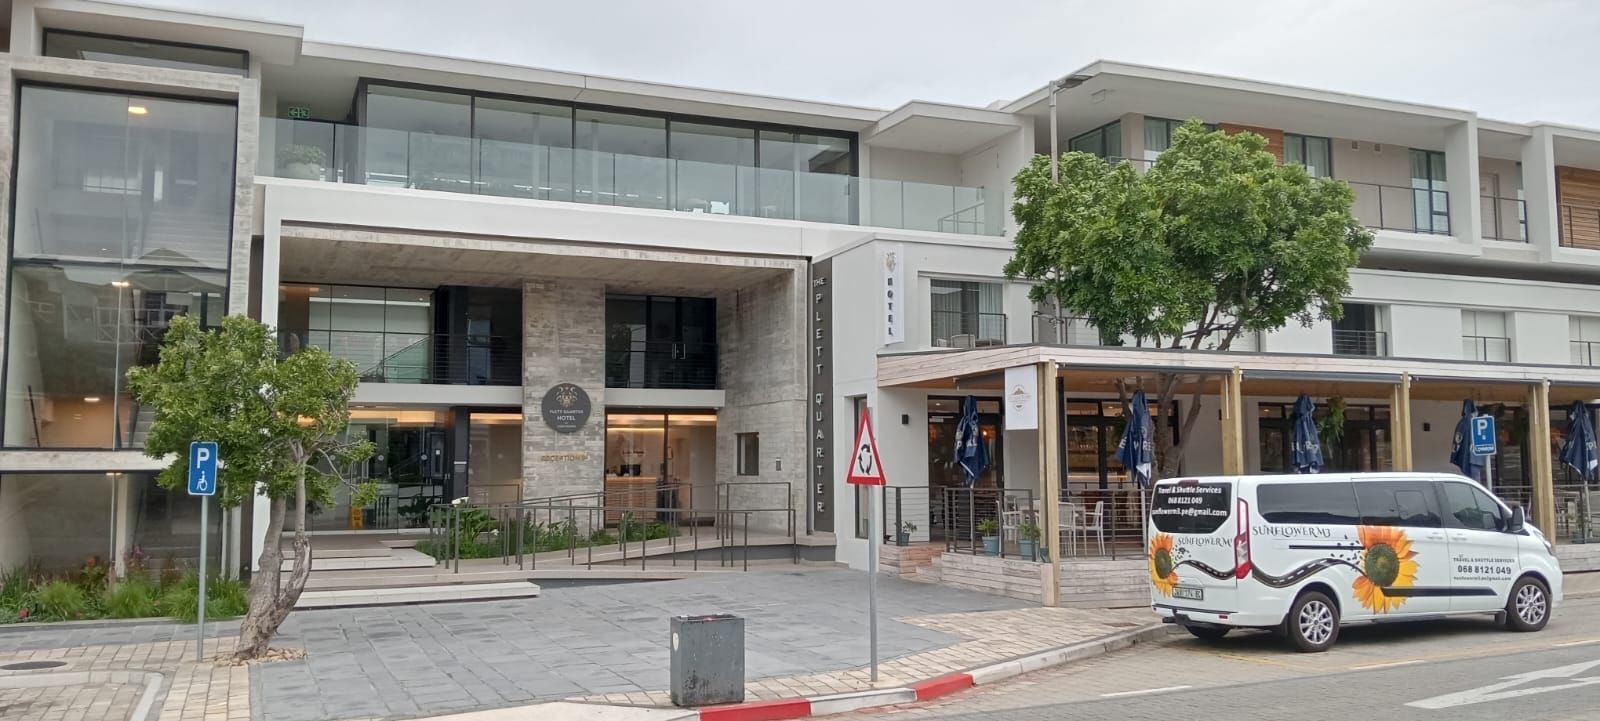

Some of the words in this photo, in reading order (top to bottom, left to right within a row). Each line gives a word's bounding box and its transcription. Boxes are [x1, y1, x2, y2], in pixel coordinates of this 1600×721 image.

[813, 277, 825, 287] THE
[815, 293, 824, 376] PLETT
[1477, 419, 1488, 436] P
[197, 447, 210, 469] P
[815, 393, 825, 513] QUARTER
[1177, 486, 1196, 494] Shuttle
[1196, 486, 1222, 494] Services
[1457, 565, 1473, 573] 068
[1474, 565, 1494, 574] 8121
[1495, 566, 1511, 574] 049
